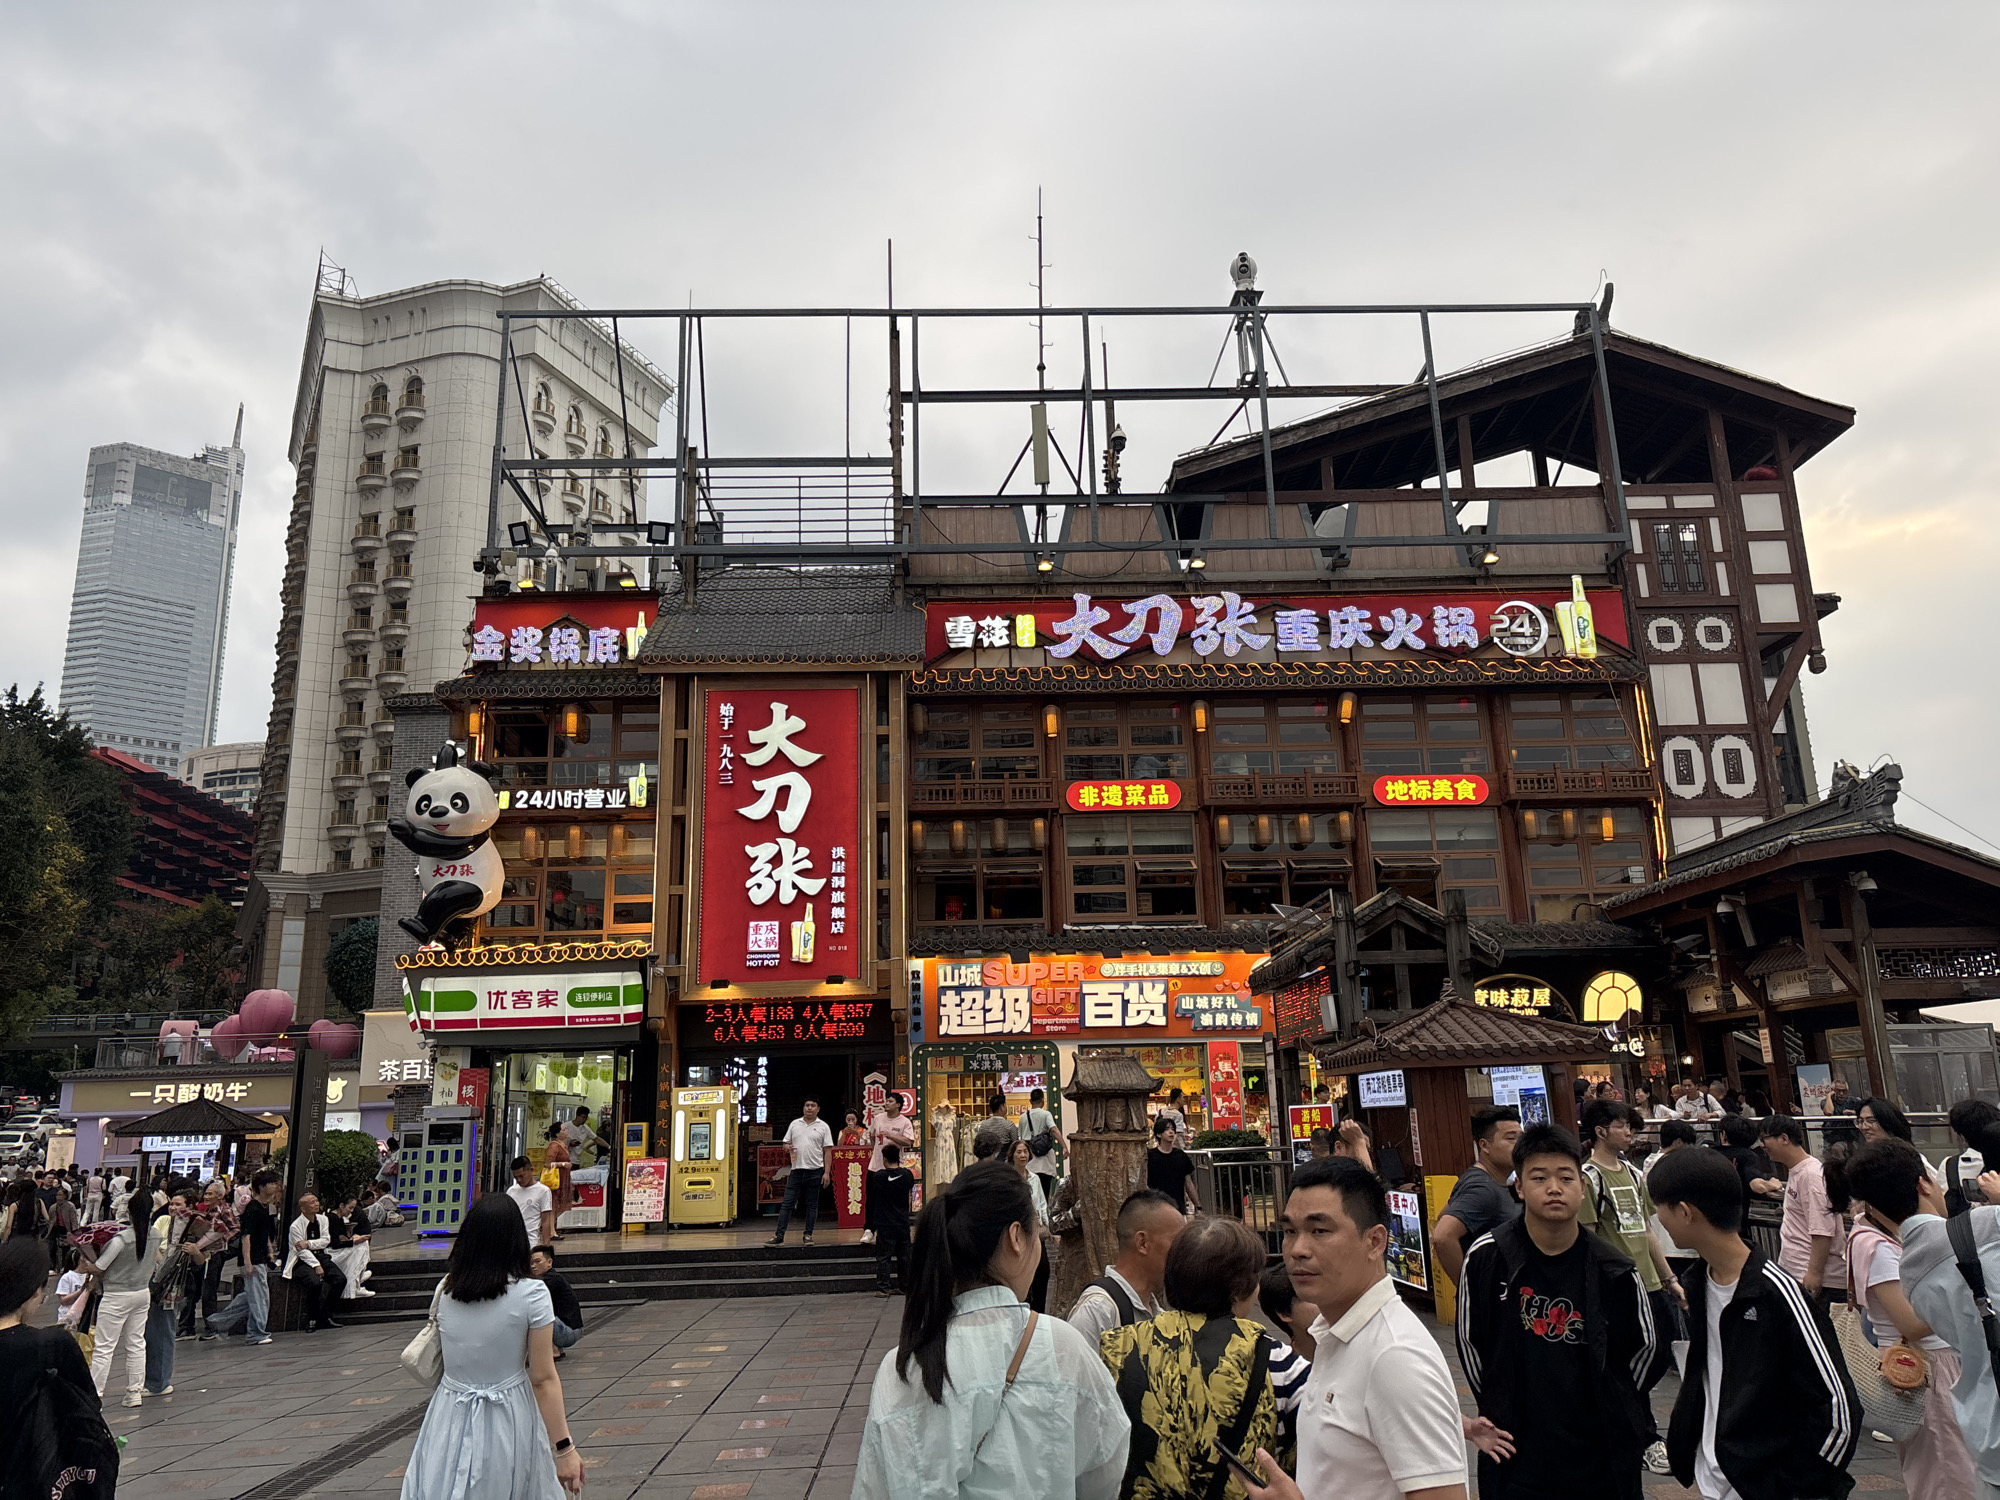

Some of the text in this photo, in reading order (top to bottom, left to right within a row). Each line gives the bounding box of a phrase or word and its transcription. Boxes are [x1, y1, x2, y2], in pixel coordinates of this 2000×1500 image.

[945, 615, 1010, 648] 雪花
[1045, 591, 1271, 659] 大刀张
[1274, 605, 1479, 652] 重庆火锅
[1490, 614, 1533, 636] 24
[471, 624, 620, 664] 金奖锅底
[718, 703, 734, 785] 始于一九八三
[515, 789, 626, 809] 24小时营业
[1078, 784, 1169, 808] 非遗菜品
[1385, 778, 1476, 801] 地标美食
[736, 702, 827, 905] 大刀张
[432, 864, 475, 877] 大刀张
[830, 846, 846, 934] 洪崖洞旗舰店
[750, 923, 778, 935] 重庆
[750, 936, 778, 949] 火锅
[938, 965, 982, 986] 山城
[983, 961, 1085, 987] SUPER
[487, 989, 559, 1010] 优客家
[1031, 987, 1080, 1005] GIFT
[1082, 982, 1167, 1027] 百货
[1181, 996, 1238, 1009] 山城好礼
[939, 988, 1031, 1035] 超级
[1032, 1017, 1079, 1026] Department
[896, 1055, 908, 1084] 重庆
[934, 1056, 958, 1068] 玩具
[969, 1060, 1004, 1071] 冰淇淋
[1013, 1054, 1036, 1067] 汽水
[130, 1082, 248, 1104] 一只酸奶牛
[1301, 1108, 1321, 1122] 游船
[847, 1162, 863, 1215] 地标美食
